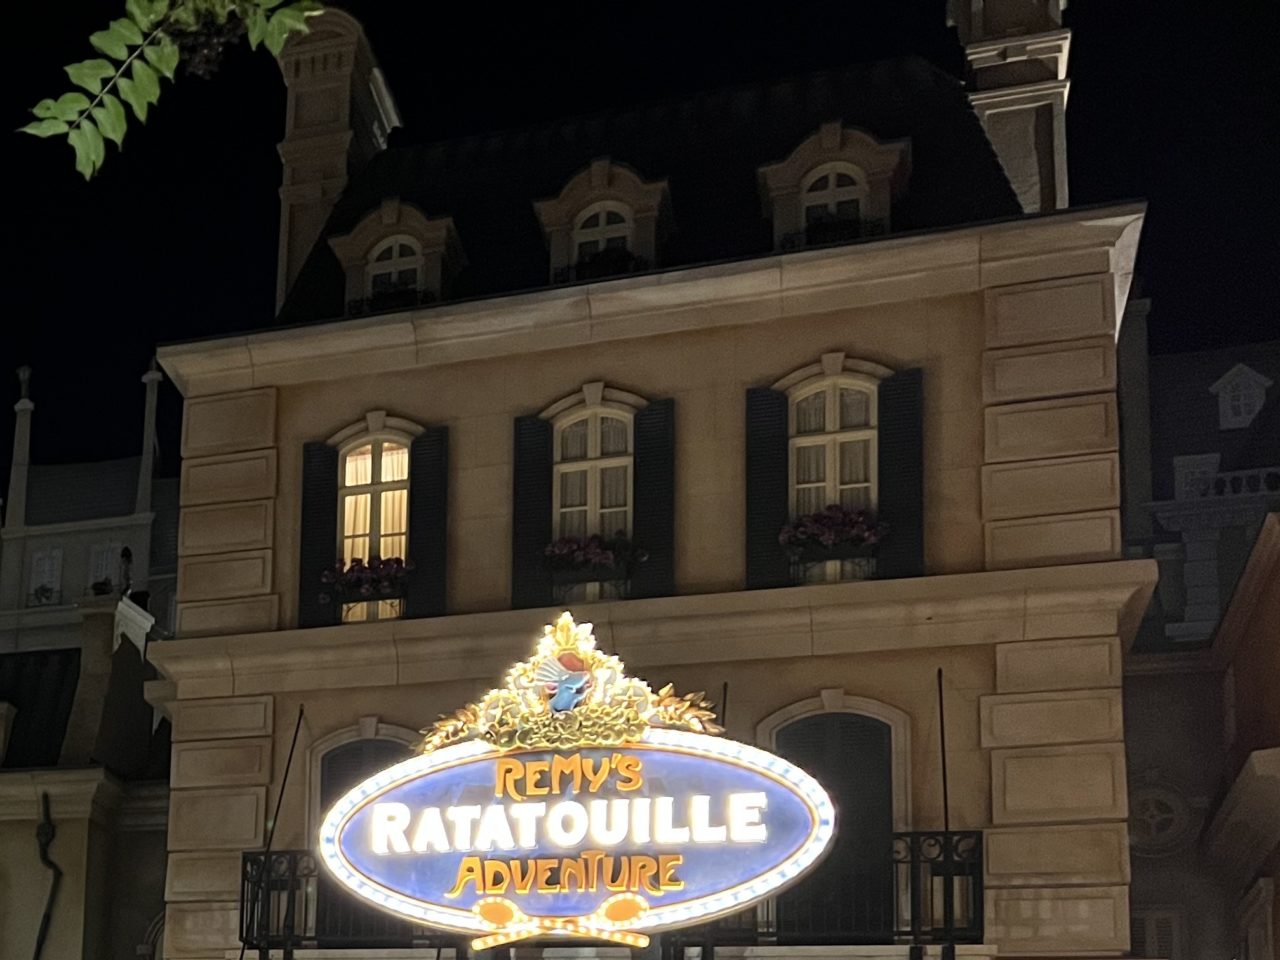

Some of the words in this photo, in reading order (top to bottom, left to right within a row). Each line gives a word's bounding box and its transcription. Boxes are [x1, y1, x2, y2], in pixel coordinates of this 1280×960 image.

[494, 752, 645, 801] REMY'S
[370, 791, 768, 856] RATATOUILLE
[444, 849, 686, 897] ADVENTURE
